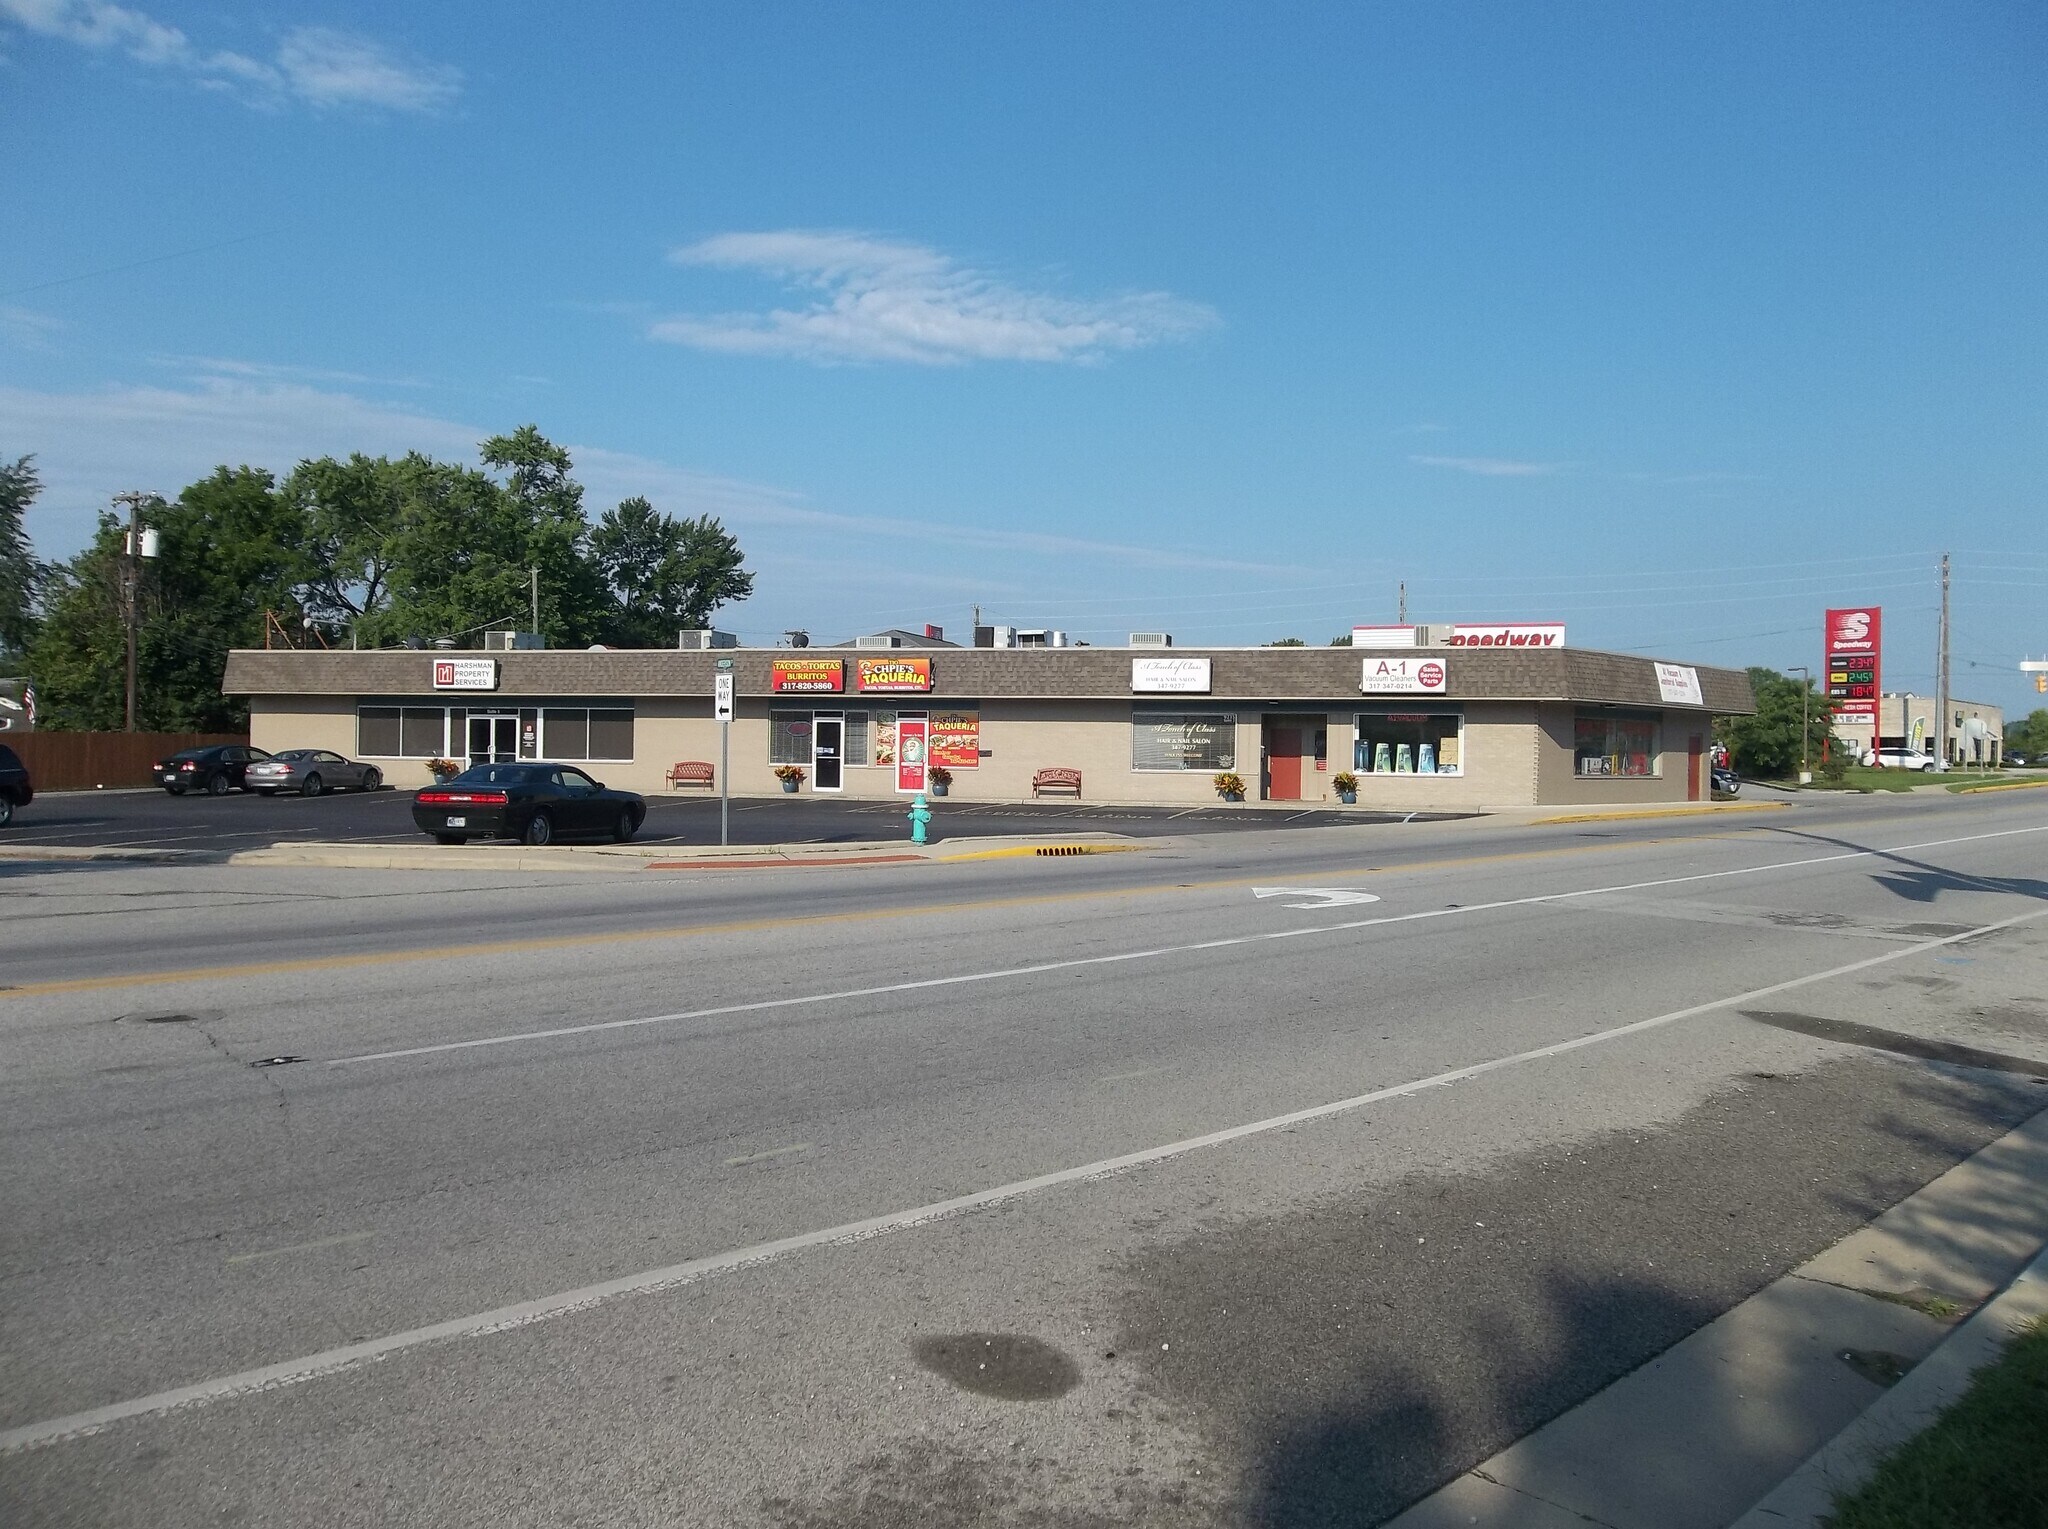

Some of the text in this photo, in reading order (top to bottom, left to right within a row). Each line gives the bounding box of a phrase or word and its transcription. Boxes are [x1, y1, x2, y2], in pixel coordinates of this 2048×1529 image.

[1450, 630, 1556, 646] peedway
[1833, 640, 1872, 650] Speedway
[775, 662, 840, 671] TACOS TORTAS
[873, 664, 915, 674] CHPIE'S
[1151, 660, 1173, 670] Touch
[1173, 660, 1183, 675] of
[1183, 661, 1202, 670] Class
[1376, 661, 1406, 675] A-1
[786, 672, 828, 680] BURRITOS
[862, 672, 926, 685] TAQUERIA
[719, 678, 729, 689] ONE
[782, 682, 832, 690] 317-820-5860
[718, 691, 730, 702] WAY
[933, 722, 976, 732] TAQUERIA
[1162, 722, 1185, 732] Touch
[1186, 722, 1196, 738] of
[1196, 723, 1216, 732] Class
